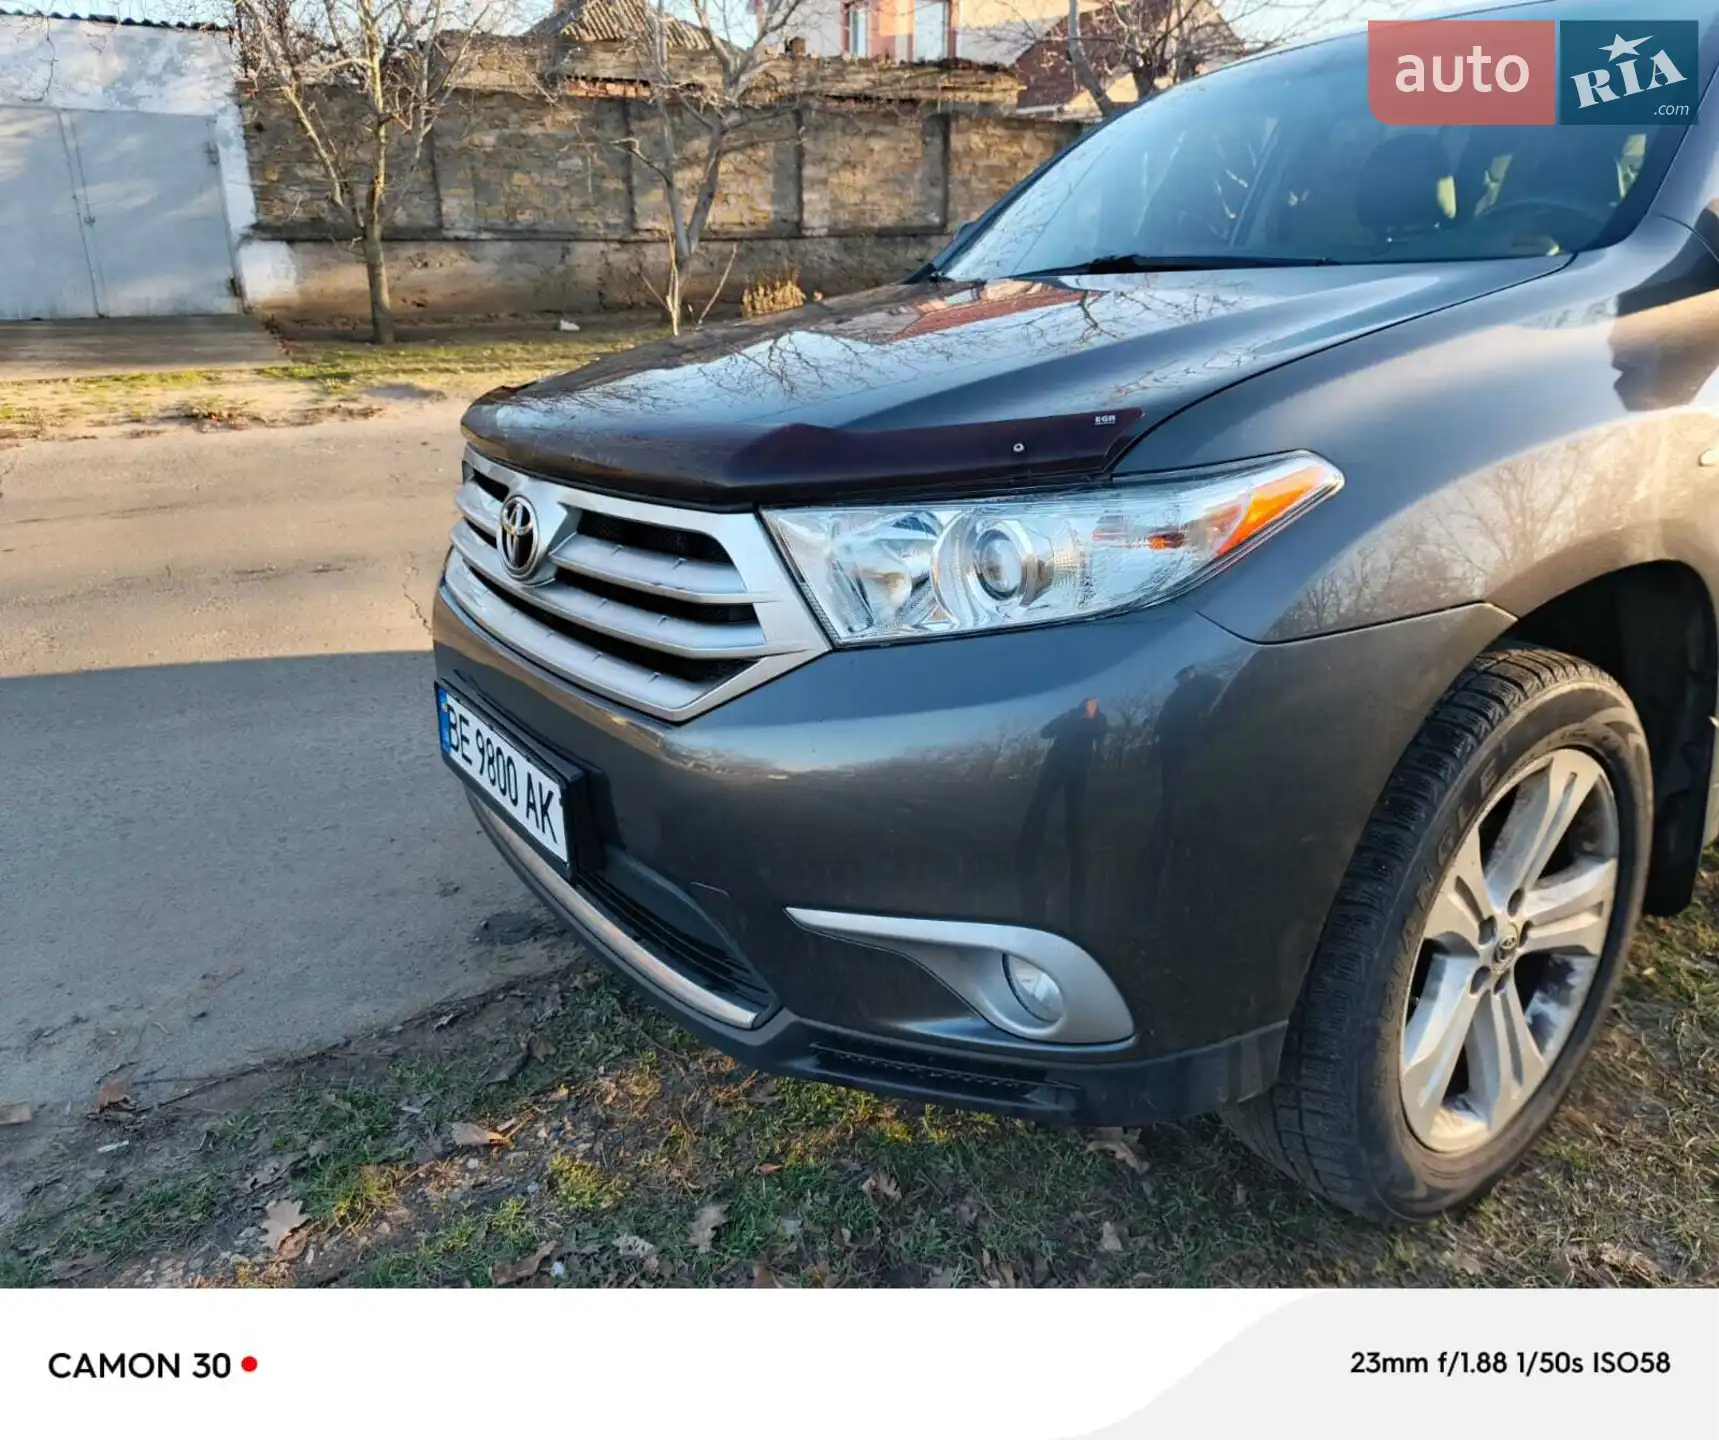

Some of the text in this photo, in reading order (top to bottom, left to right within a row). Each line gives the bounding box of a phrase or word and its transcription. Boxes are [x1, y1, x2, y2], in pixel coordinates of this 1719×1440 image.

[447, 703, 558, 844] BE 9800 AK
